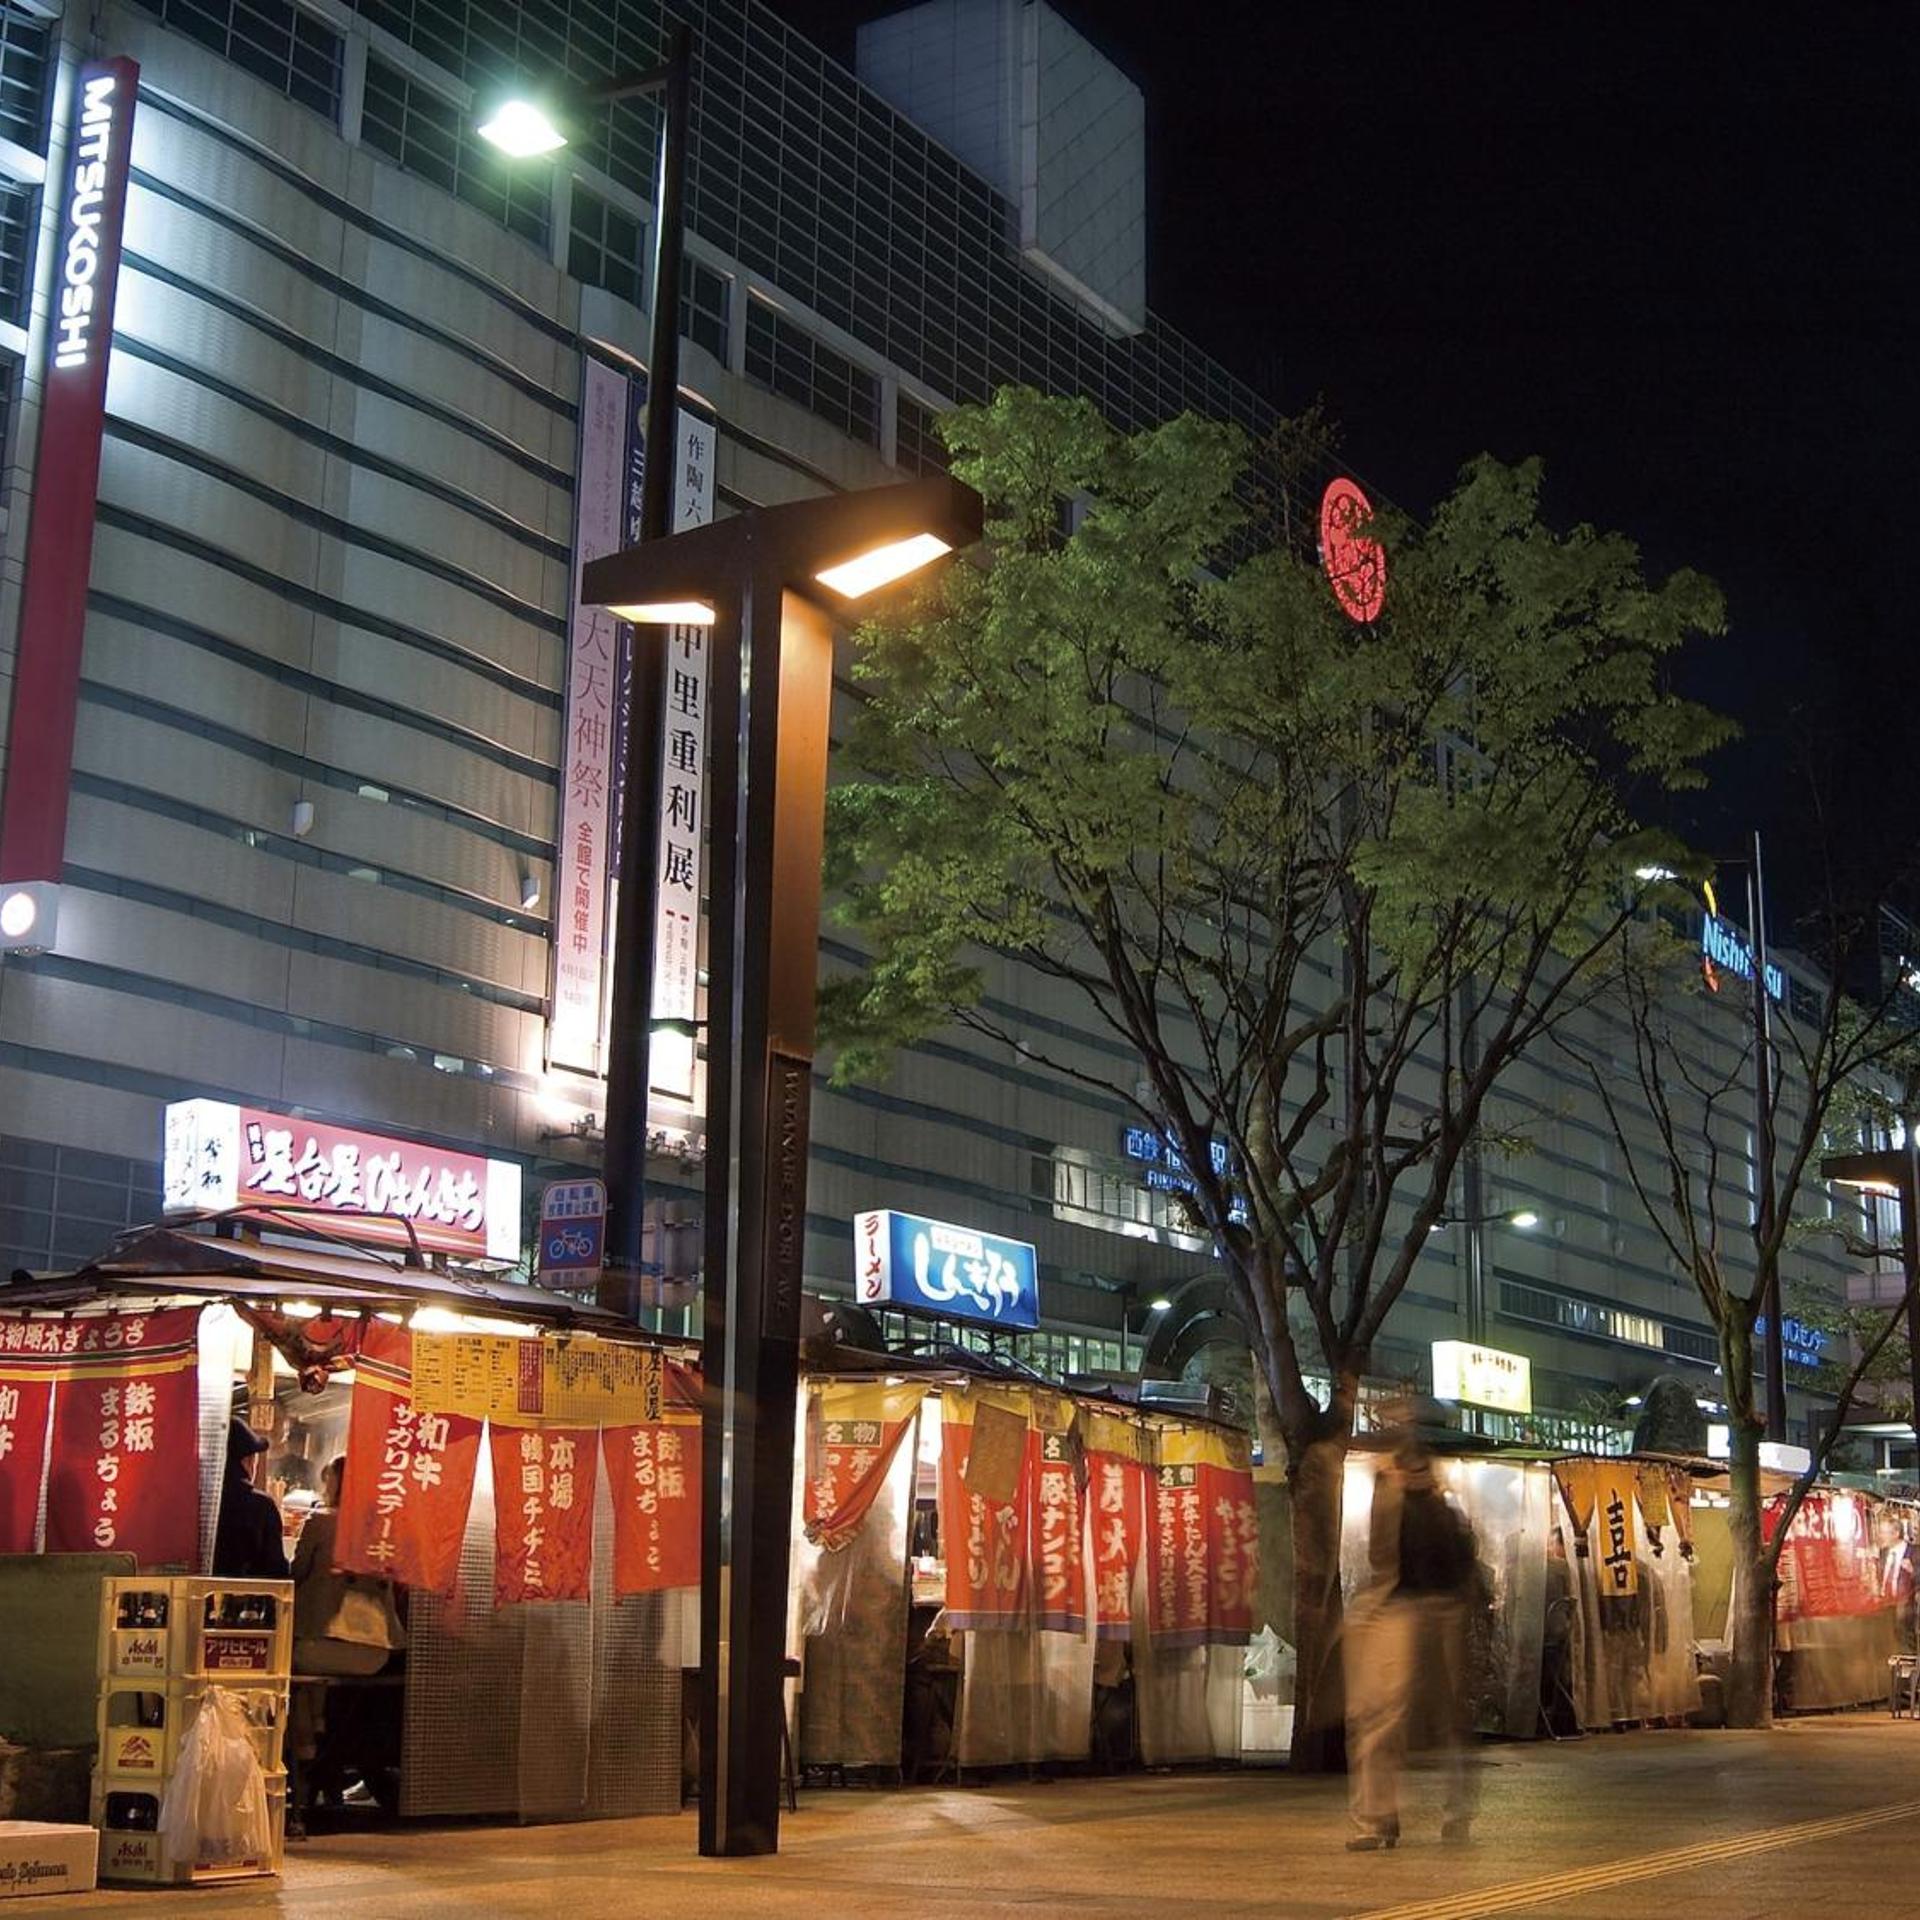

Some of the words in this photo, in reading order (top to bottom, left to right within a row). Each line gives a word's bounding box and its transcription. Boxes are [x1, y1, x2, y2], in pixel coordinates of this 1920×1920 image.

[55, 75, 116, 369] MITSUKOSHI
[863, 1214, 883, 1299] ラーメン
[0, 1317, 149, 1352] 物明太ぎょうざ
[412, 1413, 450, 1493] 和牛
[550, 1436, 576, 1511] 本場
